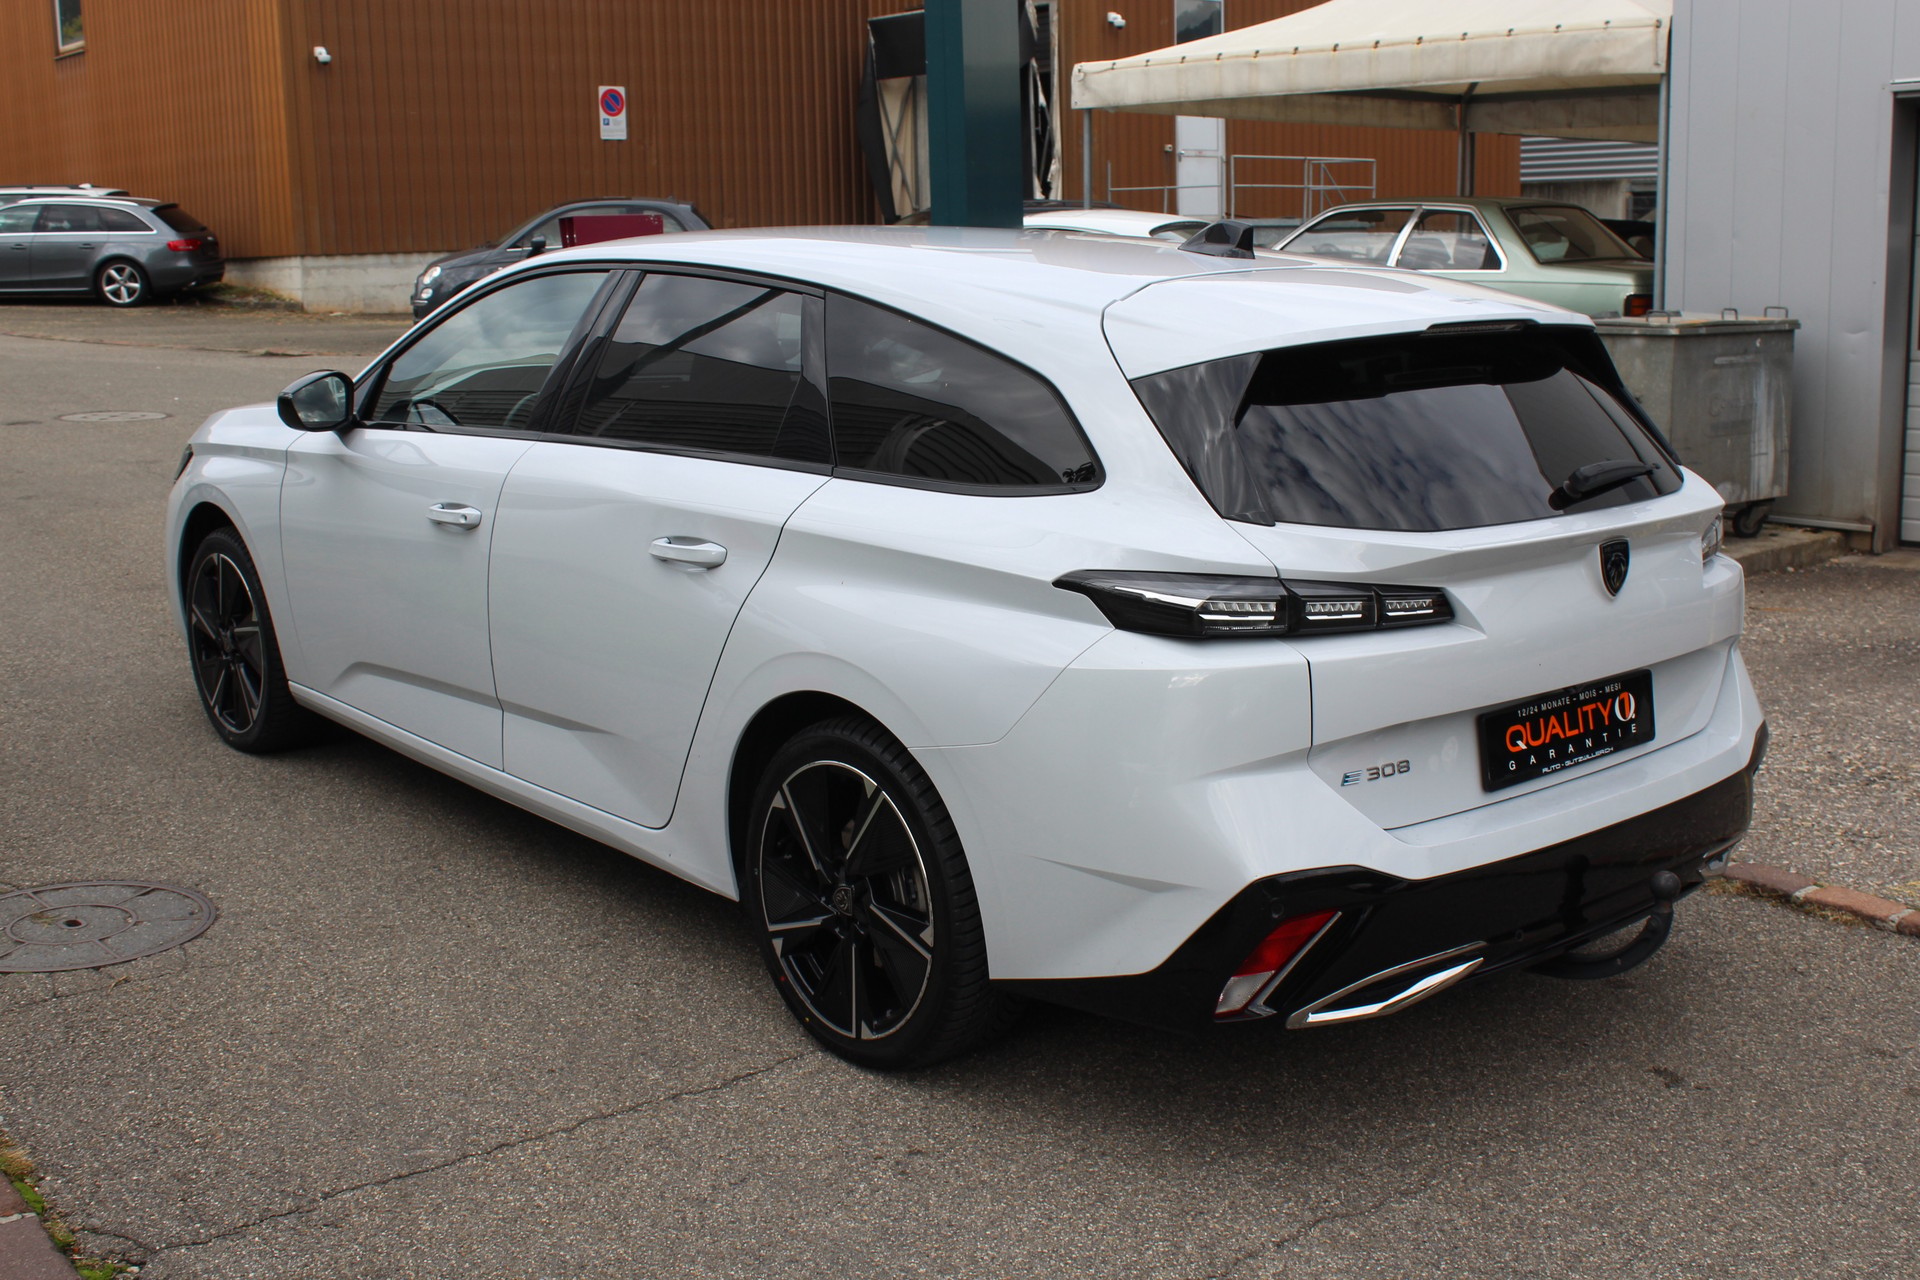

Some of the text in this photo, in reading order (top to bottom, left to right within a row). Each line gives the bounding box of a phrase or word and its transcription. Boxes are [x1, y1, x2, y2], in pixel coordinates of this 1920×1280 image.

[1517, 705, 1538, 718] 12/24
[1541, 696, 1570, 711] MONATE
[1579, 689, 1597, 701] MOIS
[1604, 682, 1622, 694] MESI
[1505, 698, 1612, 753] QUALITY
[1366, 759, 1411, 782] 308
